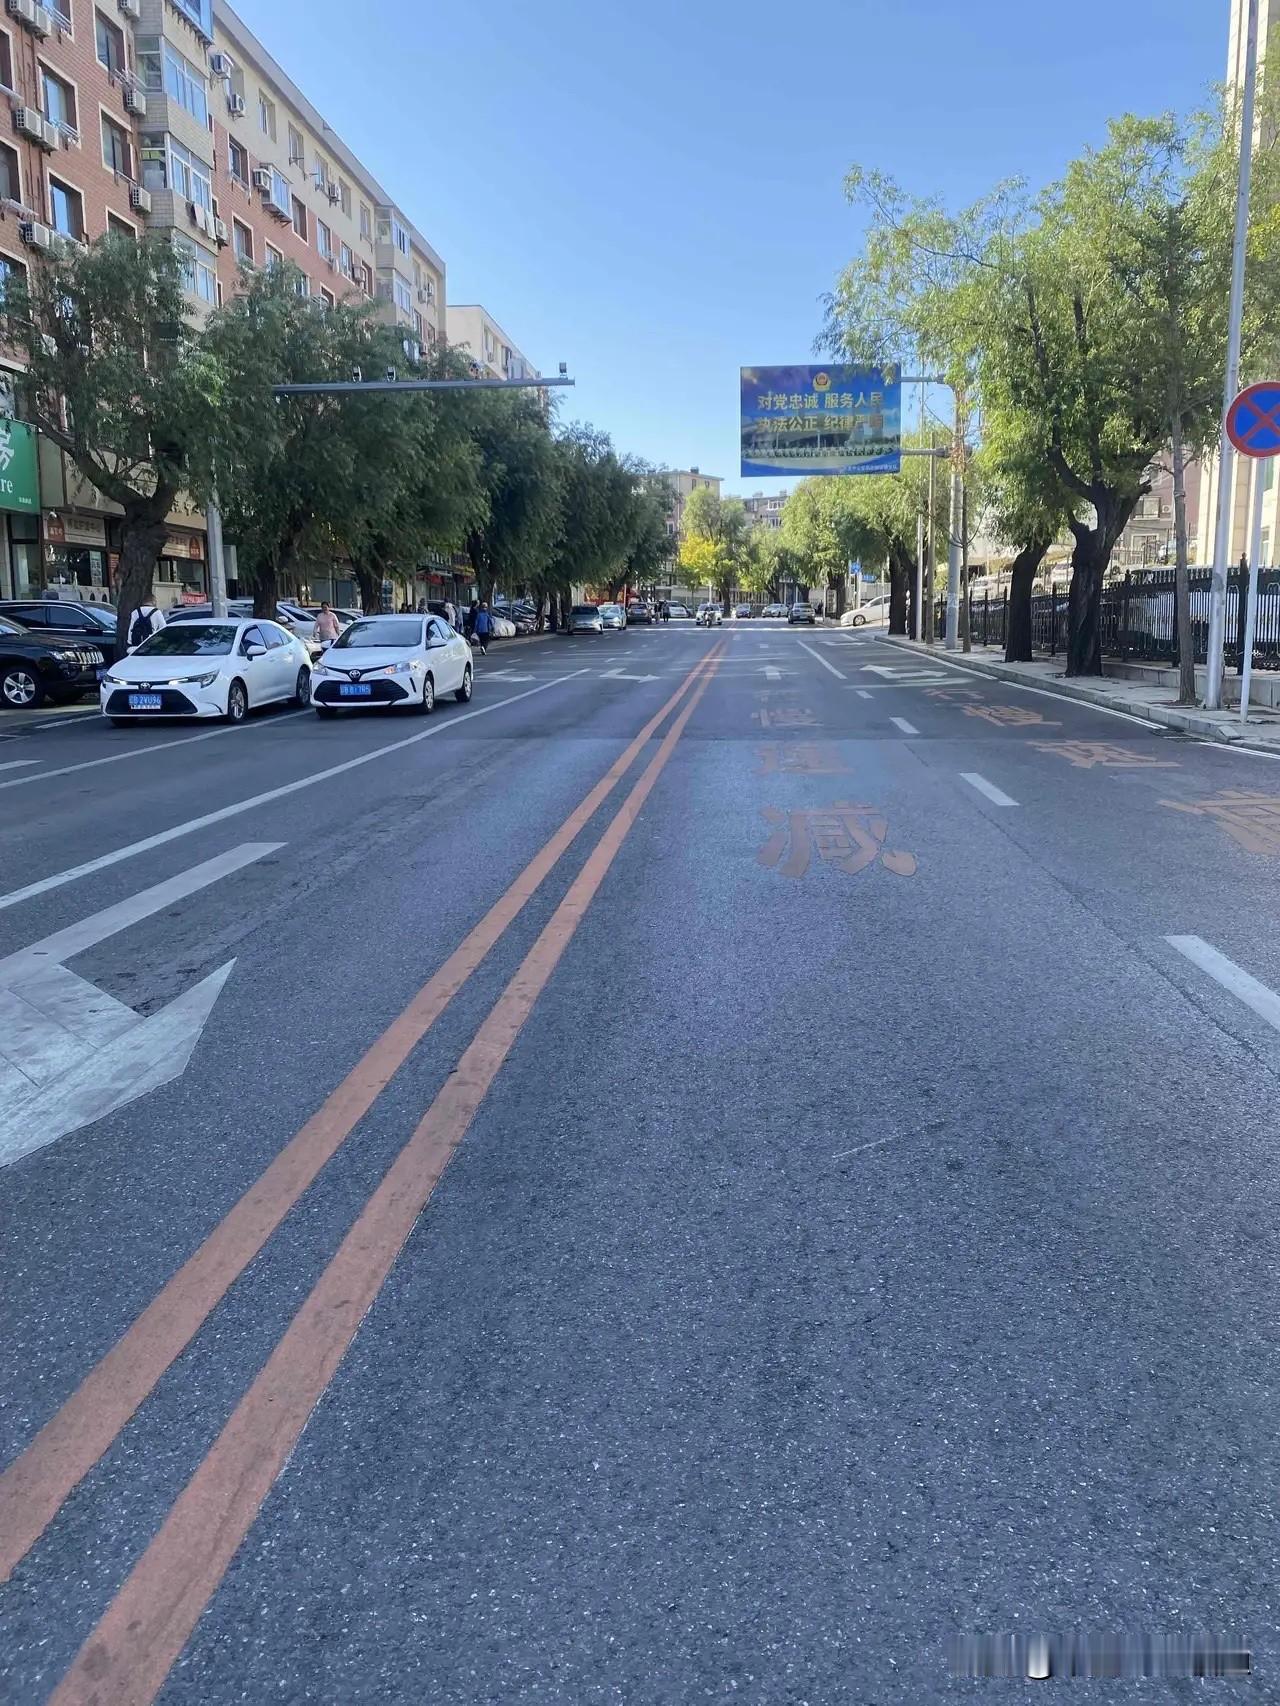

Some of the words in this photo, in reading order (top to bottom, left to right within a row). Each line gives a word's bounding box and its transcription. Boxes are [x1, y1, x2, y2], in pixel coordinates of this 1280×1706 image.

[758, 391, 818, 410] 对党忠诚
[825, 391, 882, 409] 服务人民
[757, 416, 817, 432] 执法公正
[824, 414, 882, 432] 纪律严
